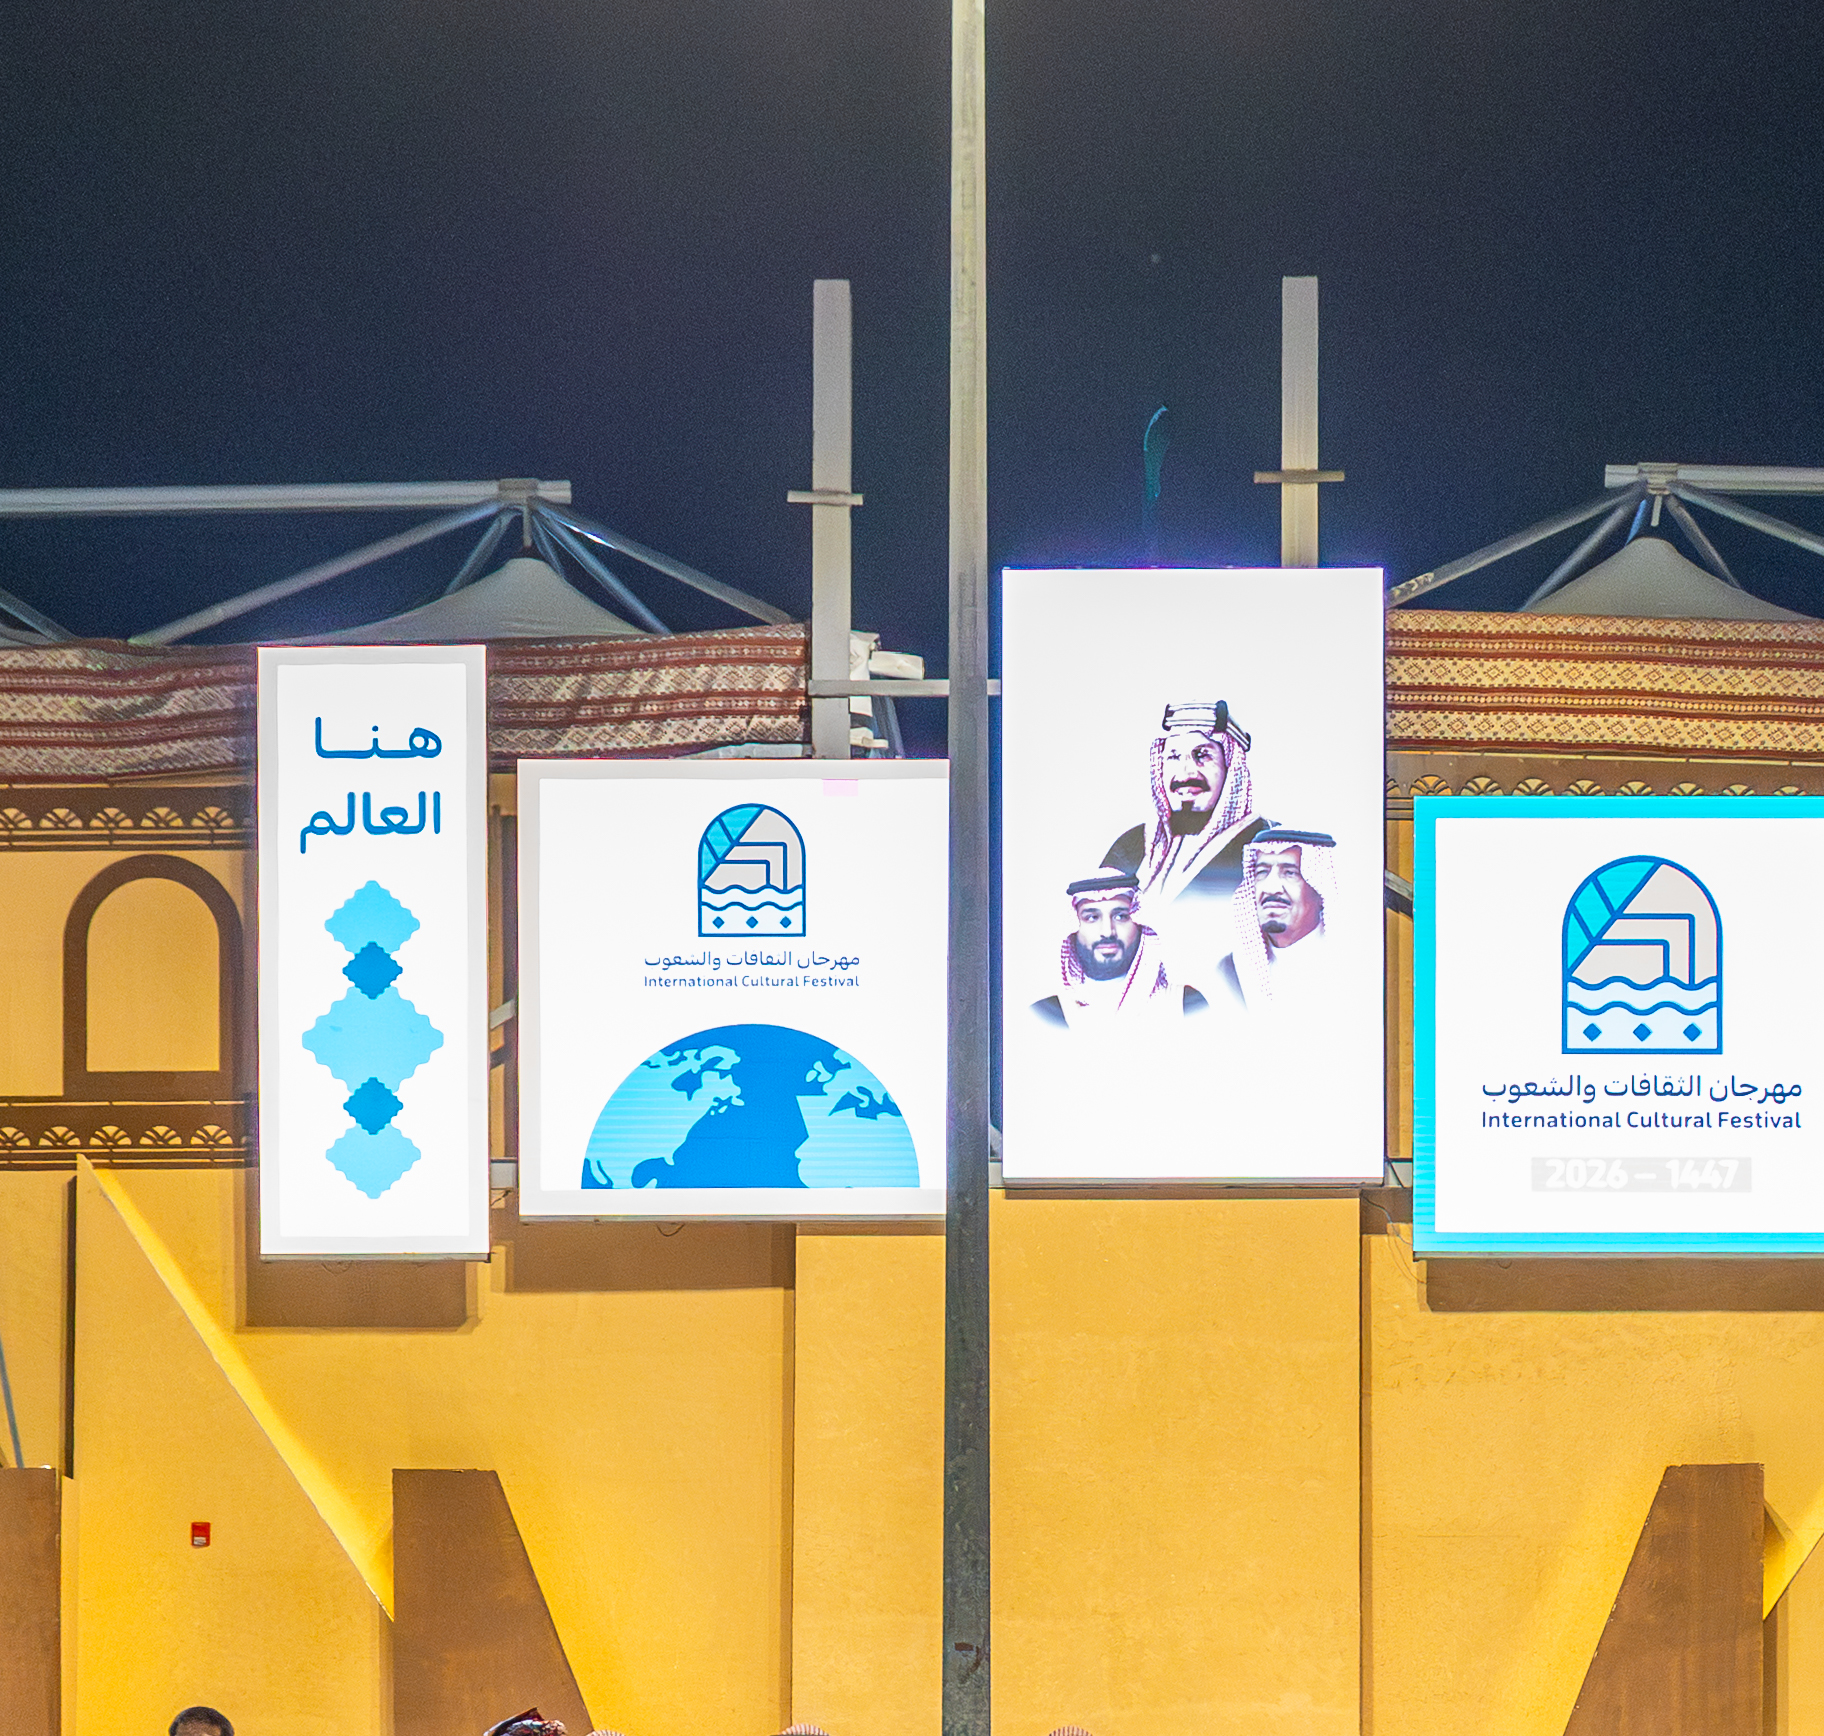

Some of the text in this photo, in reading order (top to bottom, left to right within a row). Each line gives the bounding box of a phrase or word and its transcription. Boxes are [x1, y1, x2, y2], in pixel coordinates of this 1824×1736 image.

[314, 716, 443, 760] هنا
[299, 790, 442, 855] العالم
[644, 975, 860, 988] International Cultural Festival
[1482, 1072, 1803, 1105] مهرجان الثقافات والشعوب
[1482, 1110, 1803, 1129] International Cultural Festival
[1544, 1158, 1629, 1190] 2026
[1665, 1158, 1740, 1190] 1447
